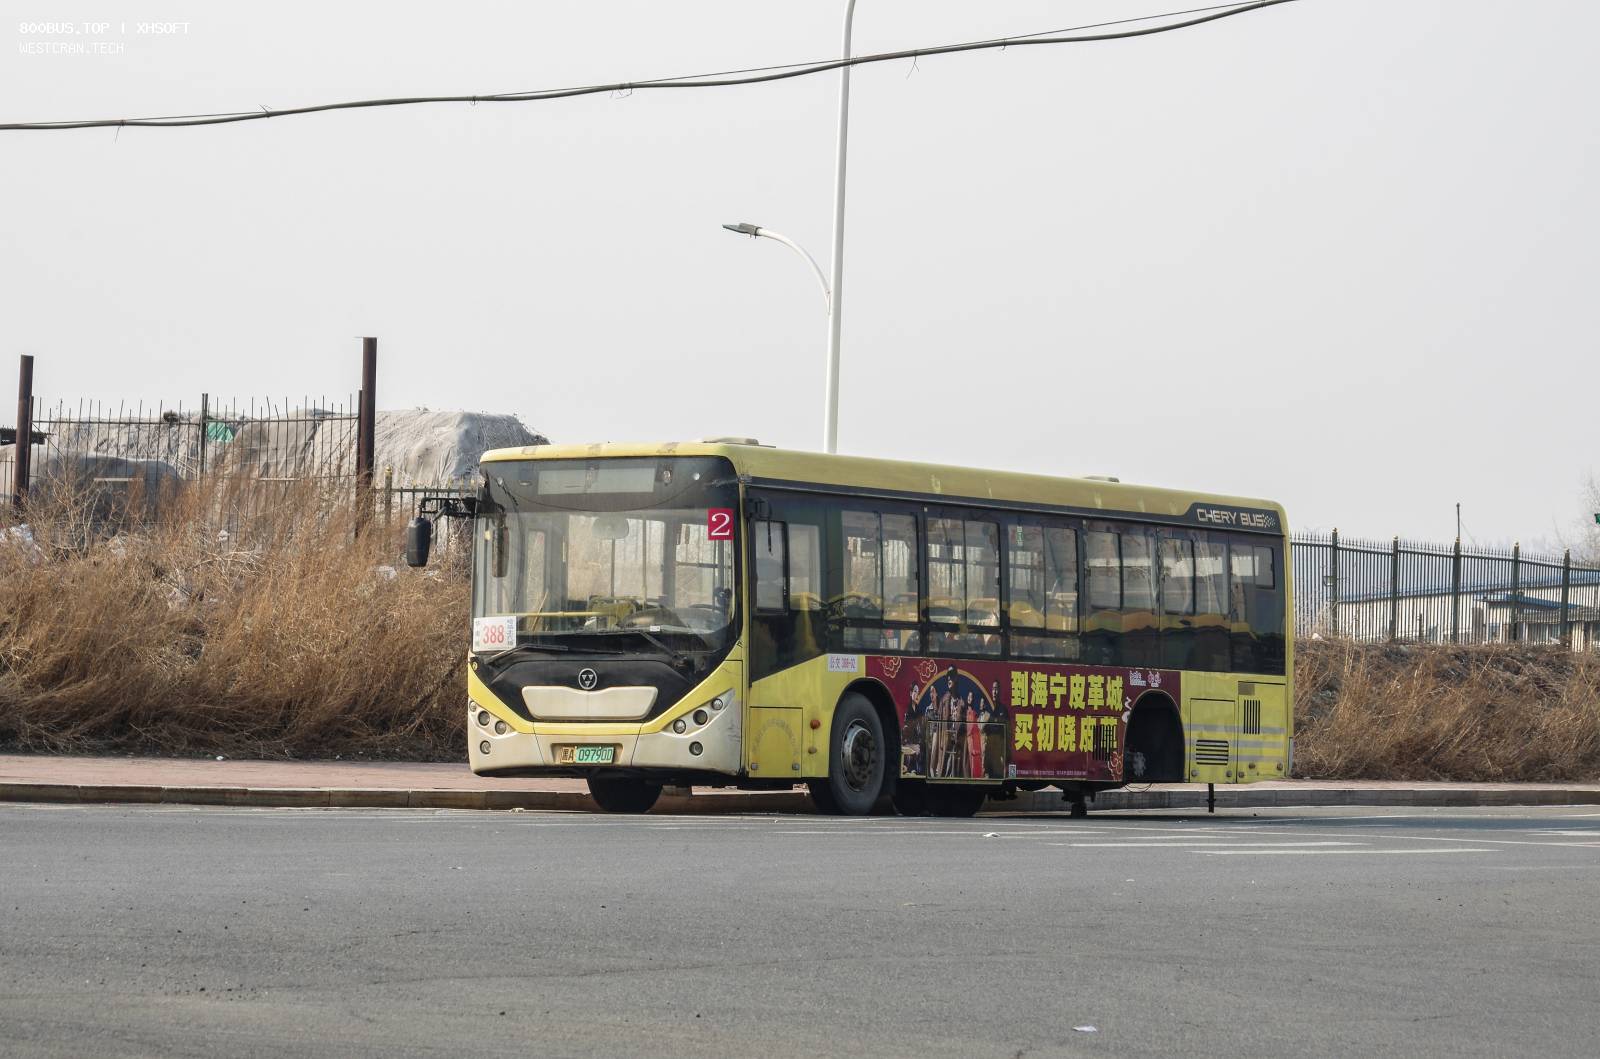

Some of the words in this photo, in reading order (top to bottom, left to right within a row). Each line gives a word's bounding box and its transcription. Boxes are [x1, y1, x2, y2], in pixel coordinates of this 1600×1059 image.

[711, 512, 730, 536] 2
[1197, 508, 1237, 525] CHERY
[1240, 512, 1264, 528] BUS
[483, 624, 504, 644] 388
[1011, 671, 1123, 711] 到海宁皮革城
